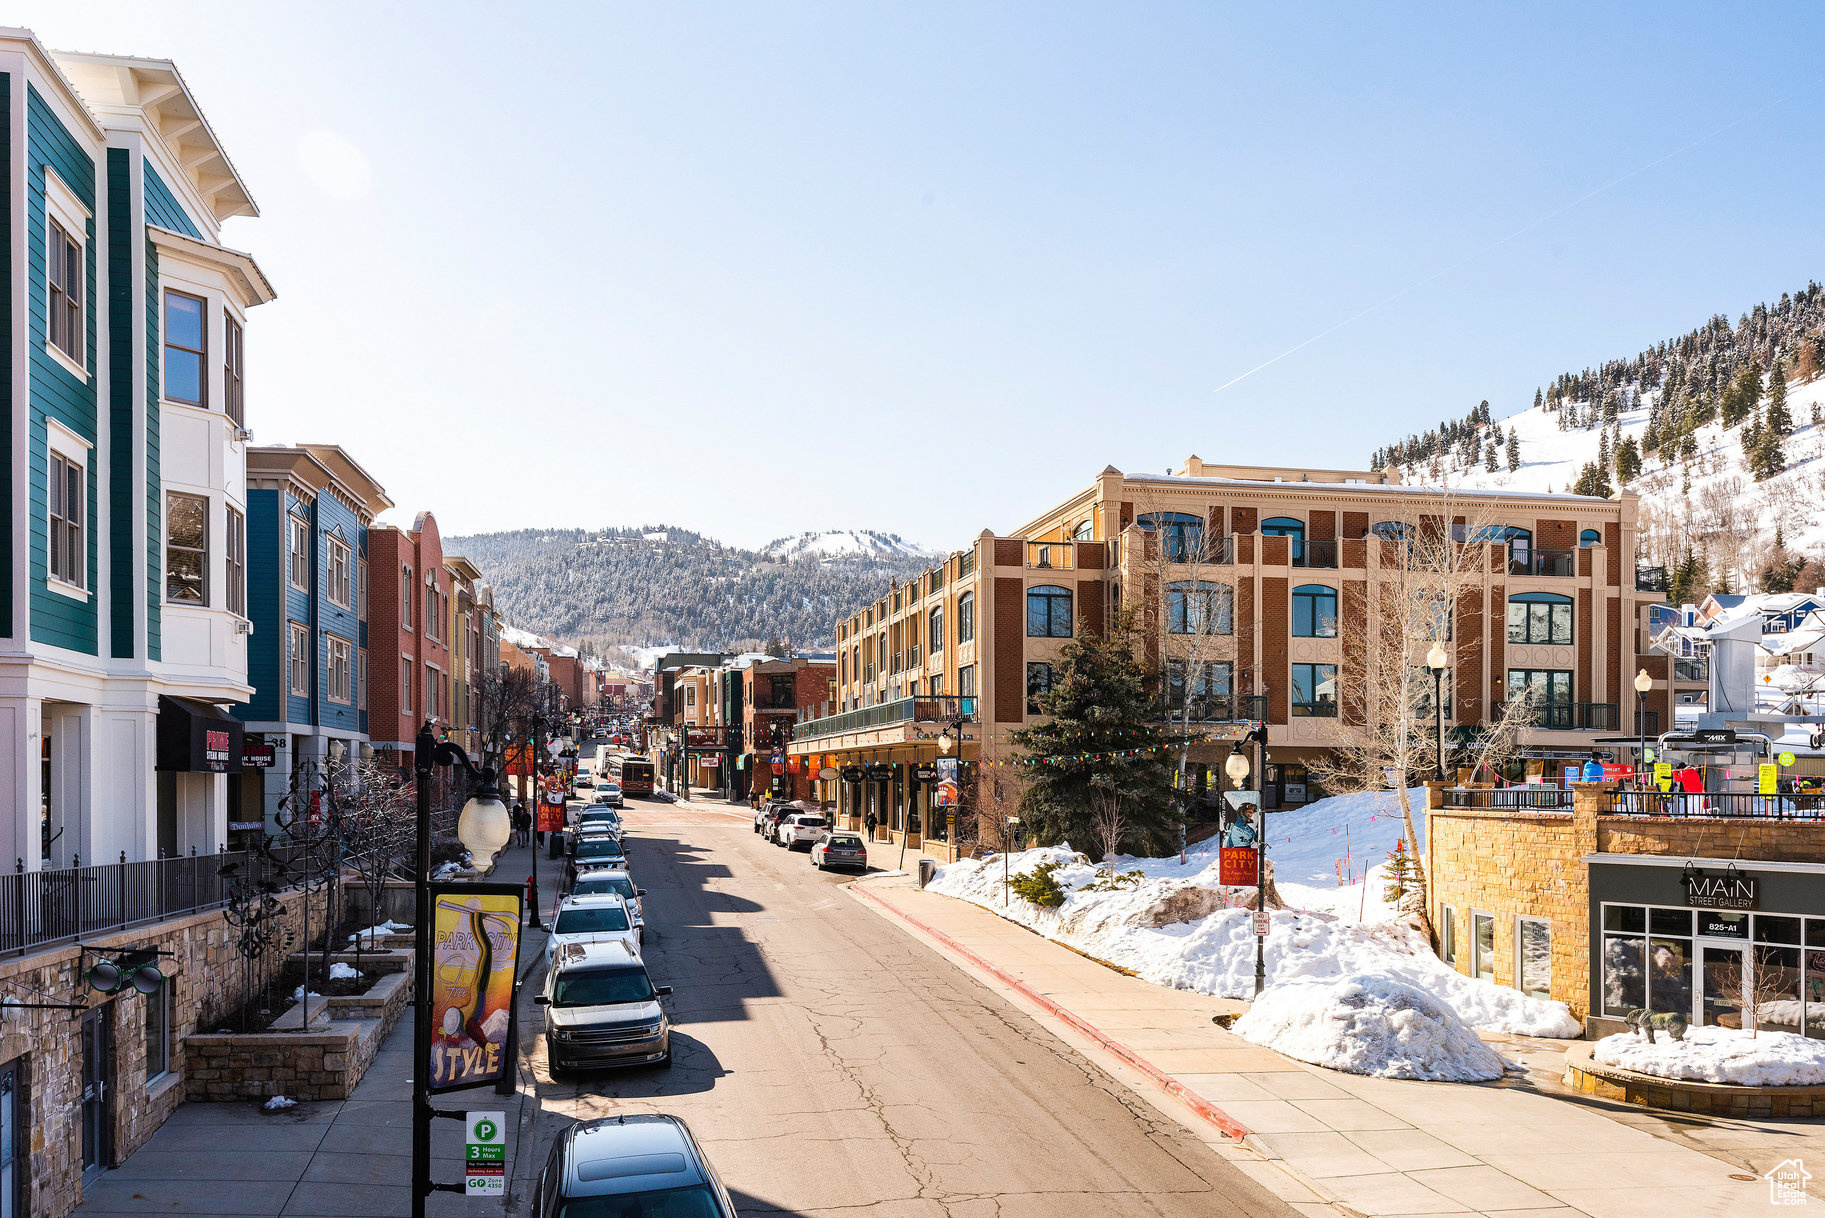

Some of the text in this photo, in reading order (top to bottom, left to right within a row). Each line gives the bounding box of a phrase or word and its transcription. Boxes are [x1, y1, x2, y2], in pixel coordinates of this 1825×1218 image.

[206, 730, 229, 751] PRIME
[206, 751, 229, 760] STEAK HOUSE
[1224, 851, 1254, 859] PARK
[1224, 860, 1254, 868] CITY
[1690, 896, 1753, 908] STREET GALLERY
[1709, 923, 1737, 931] 825-A1
[436, 930, 474, 950] PARK
[433, 1042, 500, 1082] STYLE
[481, 1124, 491, 1137] P
[471, 1146, 480, 1158] 3
